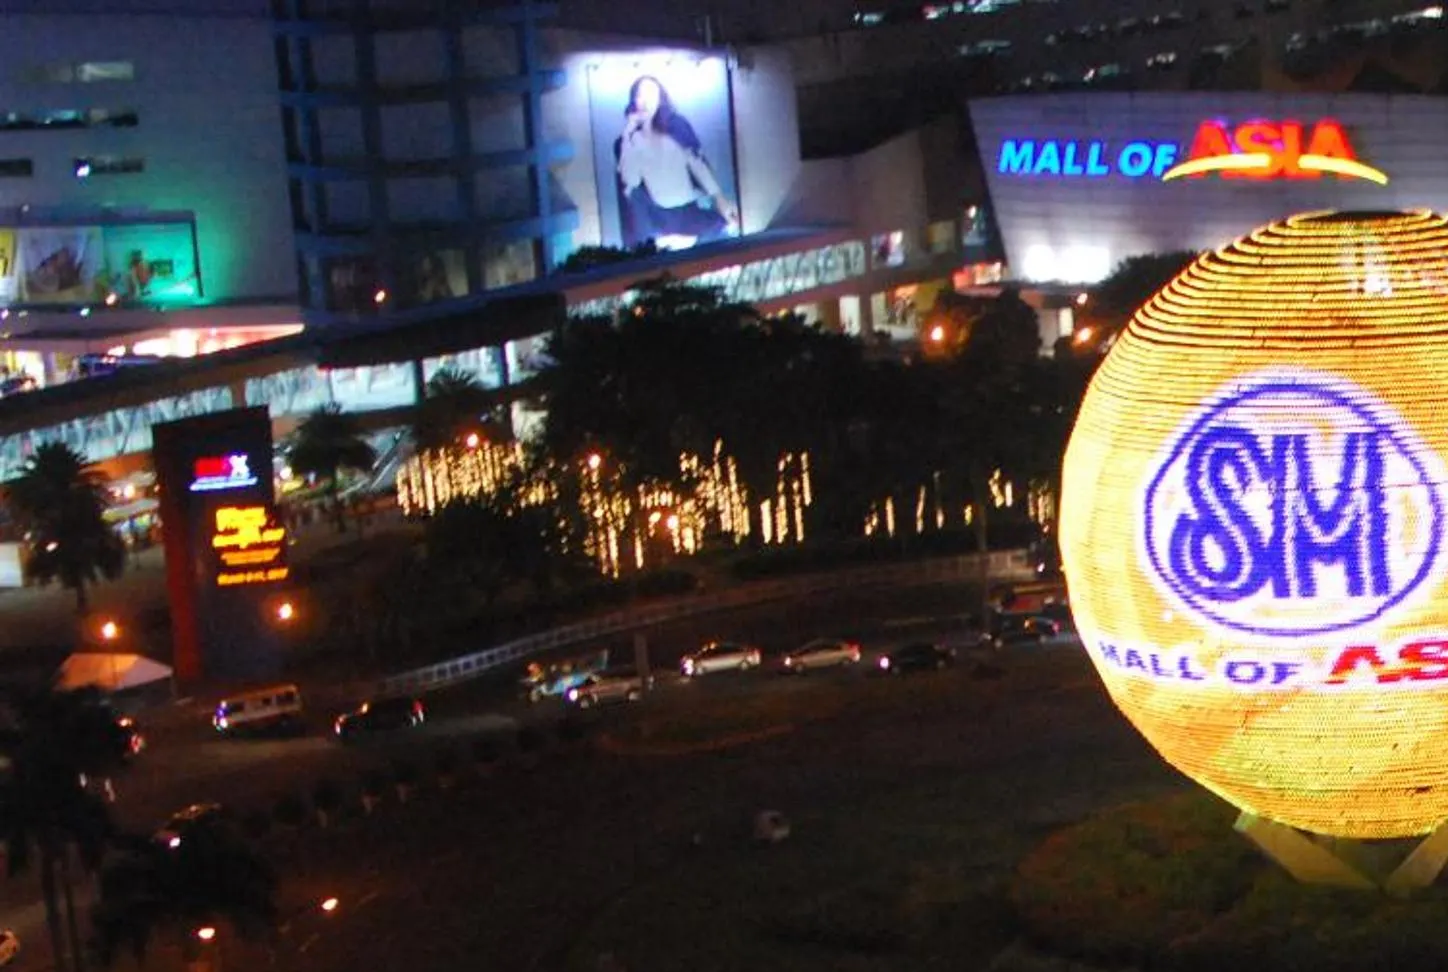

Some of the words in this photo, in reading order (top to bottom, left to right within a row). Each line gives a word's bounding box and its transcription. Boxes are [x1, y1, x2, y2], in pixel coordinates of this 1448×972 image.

[999, 139, 1109, 177] MALL
[1117, 141, 1178, 177] OF
[1189, 118, 1357, 181] ASIA
[1168, 423, 1392, 602] SM
[1098, 640, 1205, 682] MALL
[1224, 660, 1301, 685] OF
